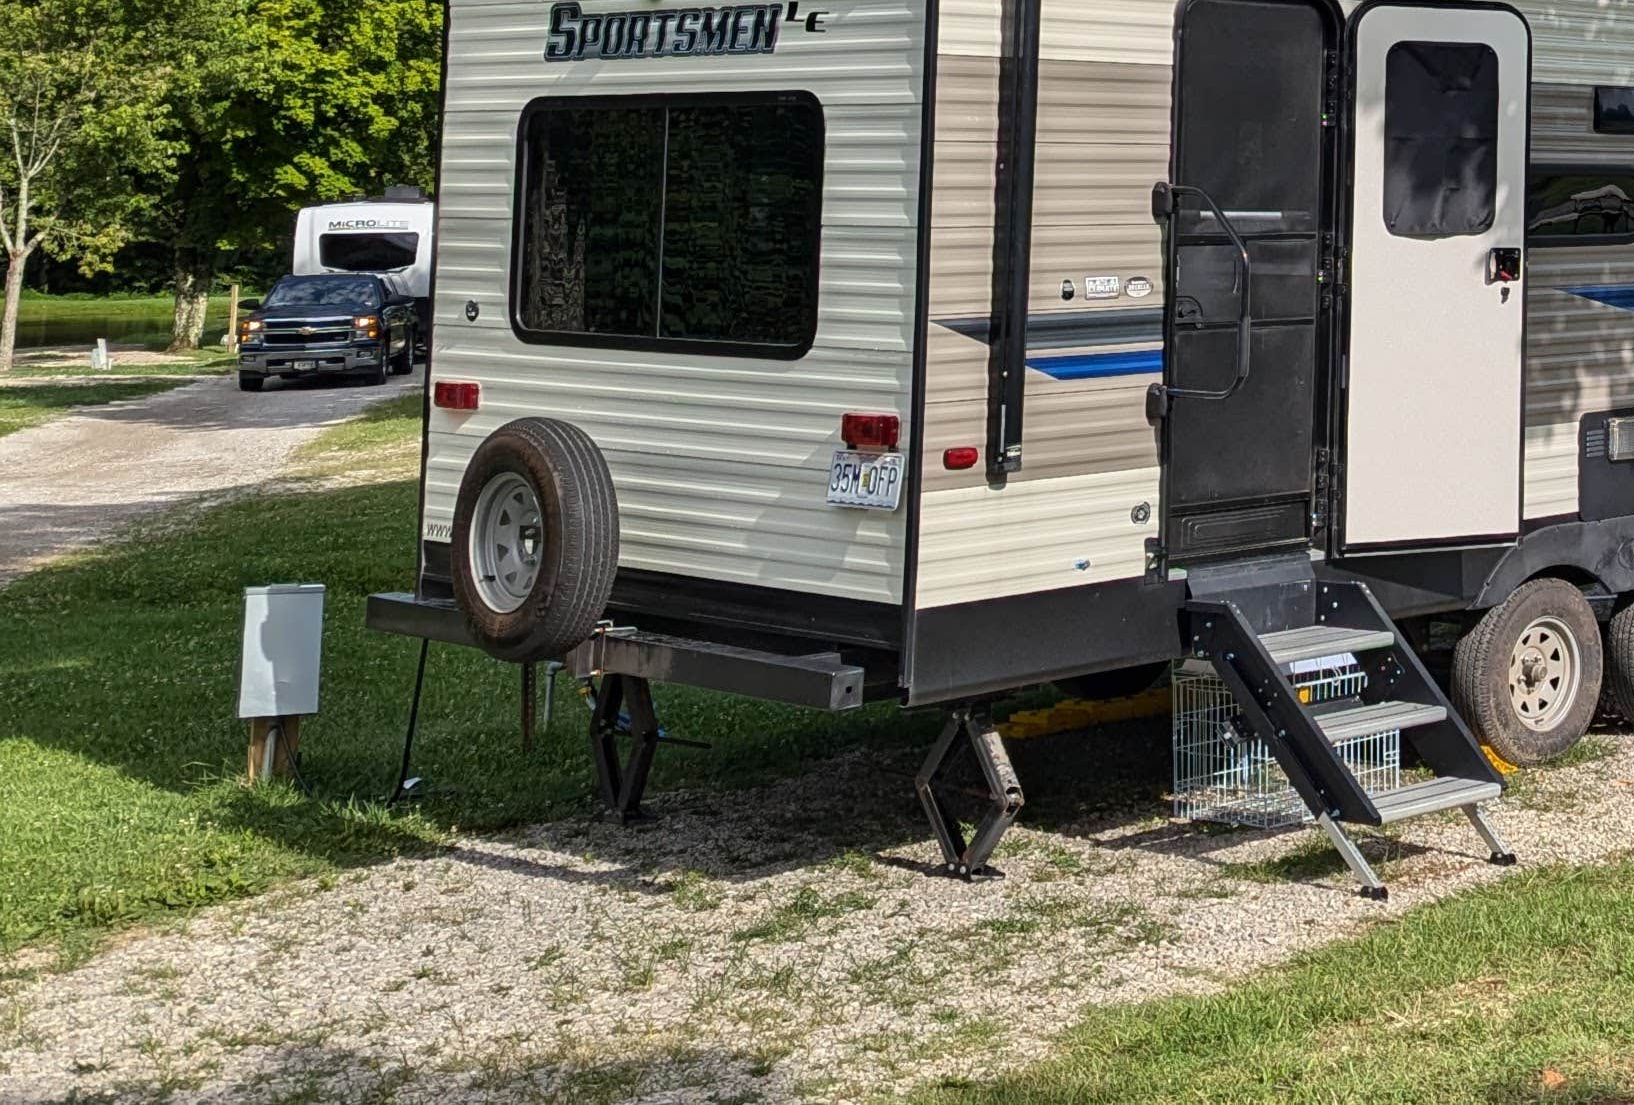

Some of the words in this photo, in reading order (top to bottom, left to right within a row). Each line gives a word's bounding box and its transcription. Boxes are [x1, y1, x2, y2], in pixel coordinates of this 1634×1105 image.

[544, 1, 783, 62] SPORTSMEN
[785, 1, 829, 33] LE
[831, 463, 861, 495] 35M
